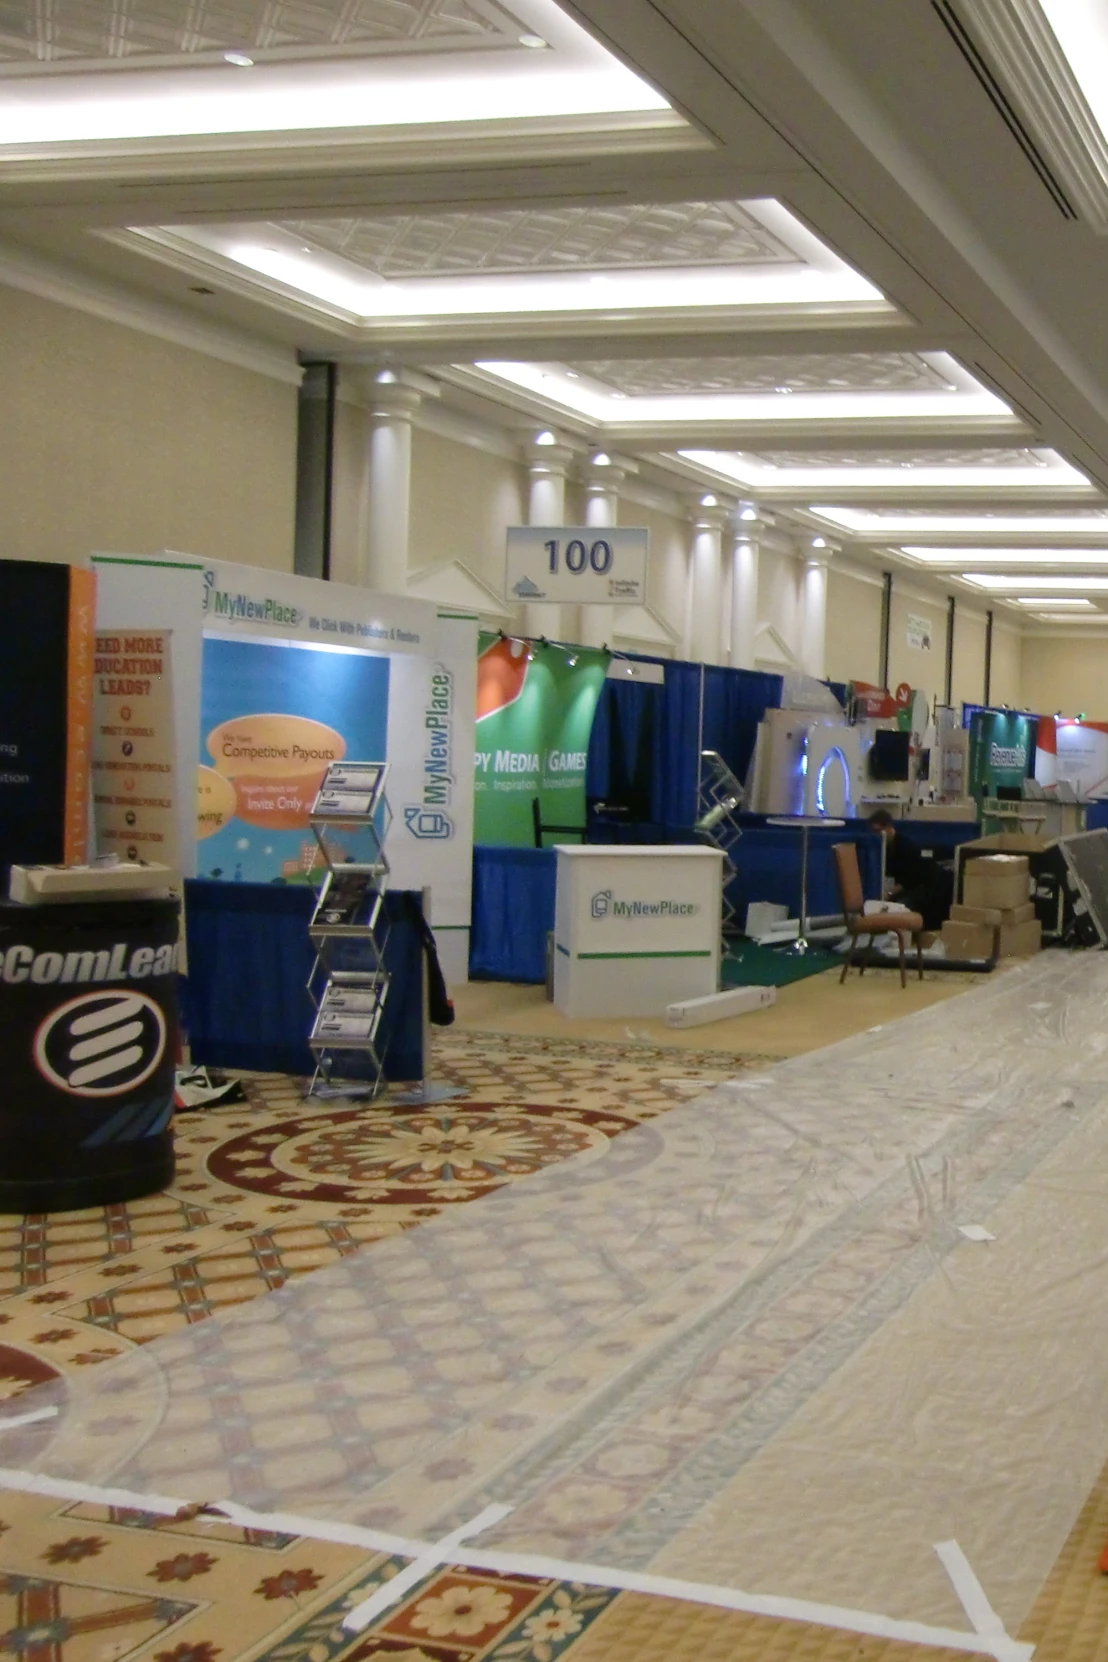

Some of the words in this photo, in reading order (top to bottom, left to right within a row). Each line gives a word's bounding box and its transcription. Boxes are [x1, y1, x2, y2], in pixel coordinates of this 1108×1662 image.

[544, 539, 612, 575] 100
[214, 591, 298, 625] MyNewPlace
[95, 638, 120, 653] EED
[124, 638, 163, 653] MORE
[94, 659, 162, 674] DUCATION
[100, 680, 151, 695] LEADS?
[423, 674, 452, 804] MyNewPlace
[223, 743, 289, 760] Competitive
[292, 745, 335, 763] Payouts
[494, 750, 540, 773] MEDIA
[548, 750, 587, 771] GAMES
[248, 798, 275, 811] Invite
[278, 797, 301, 812] Only
[613, 901, 694, 917] MyNewPlace
[0, 943, 178, 985] ComLea
